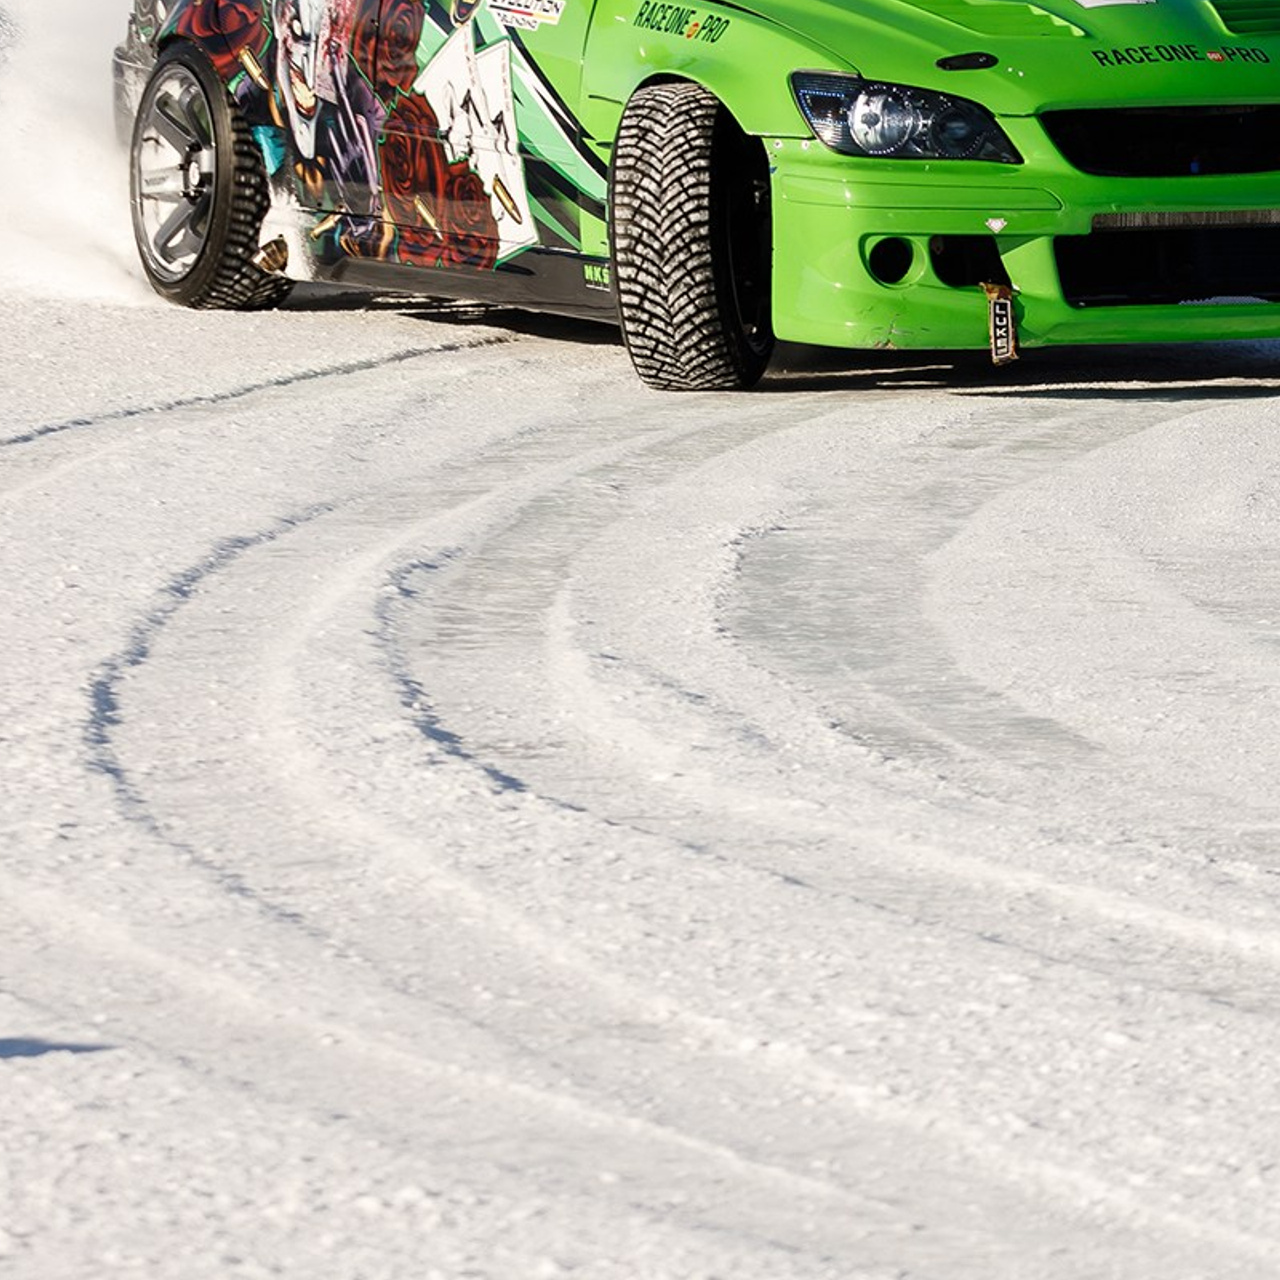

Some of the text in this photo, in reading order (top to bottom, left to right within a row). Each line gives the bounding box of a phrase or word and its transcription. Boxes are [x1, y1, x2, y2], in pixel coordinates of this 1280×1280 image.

[632, 0, 697, 35] RACEONE
[694, 14, 731, 43] PRO
[1091, 44, 1206, 67] RACEONE
[1220, 46, 1271, 63] PRO
